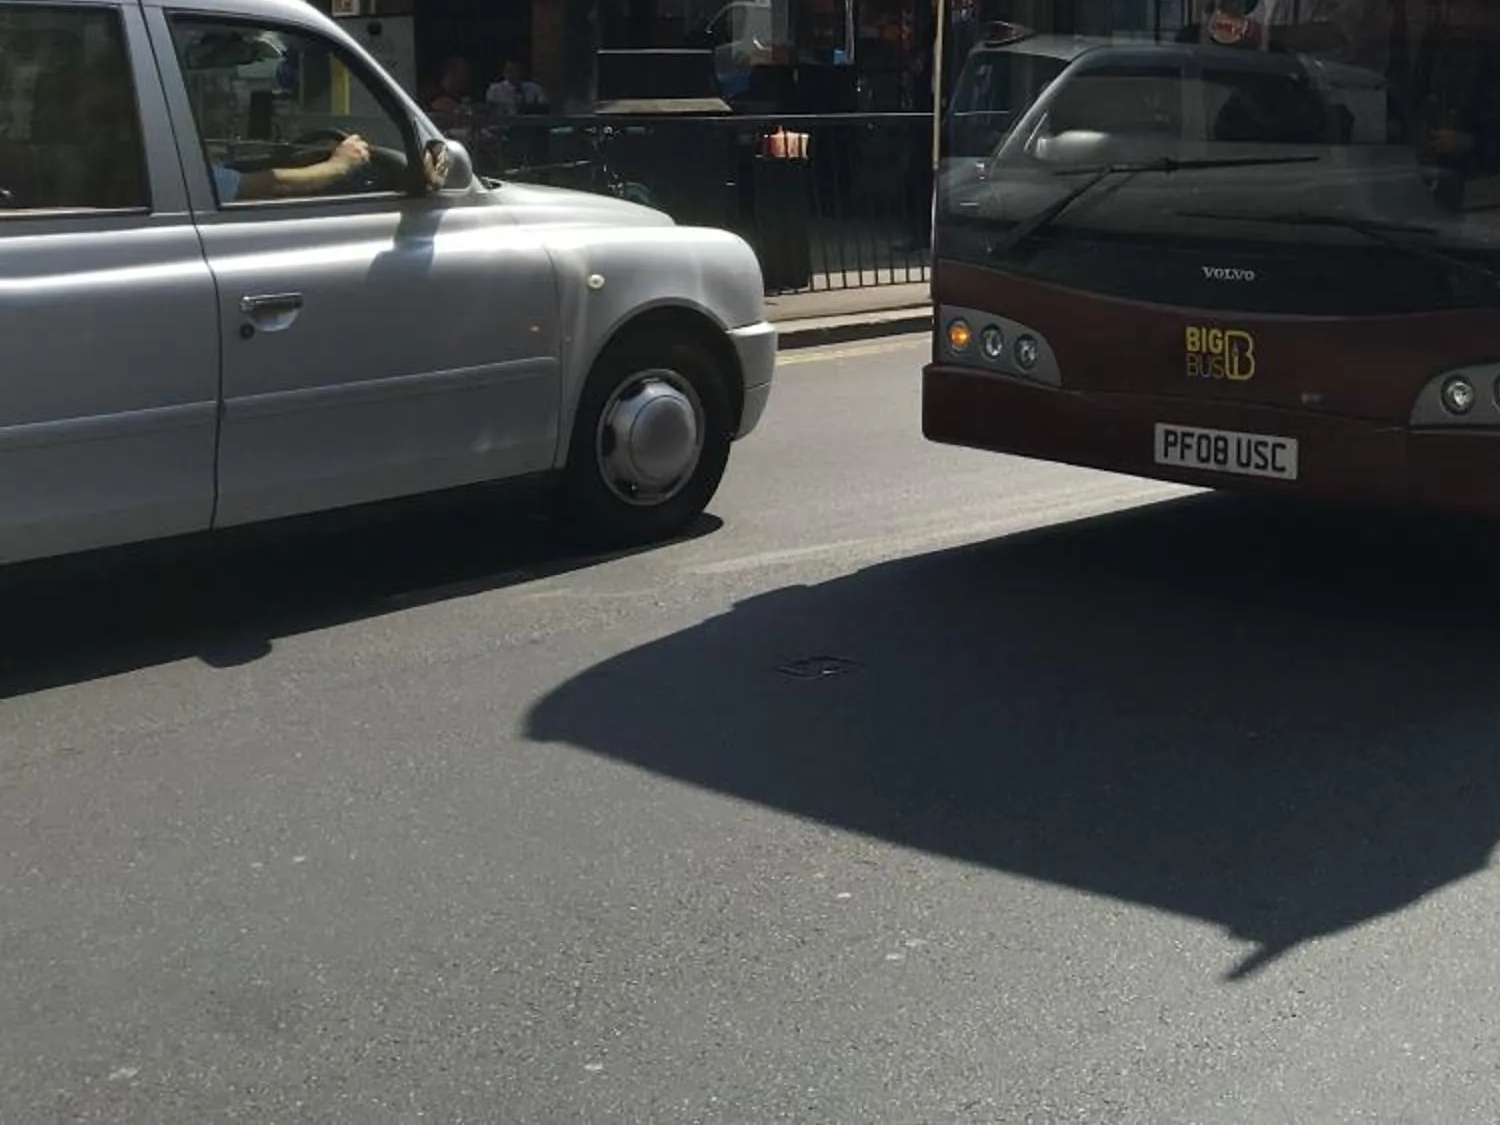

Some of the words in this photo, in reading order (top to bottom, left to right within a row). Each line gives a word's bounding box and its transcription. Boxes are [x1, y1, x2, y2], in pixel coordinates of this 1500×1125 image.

[1202, 266, 1255, 281] VOLVO
[1185, 326, 1223, 354] BIG
[1186, 352, 1225, 379] BUS
[1163, 429, 1228, 465] PF08
[1236, 438, 1286, 473] USC
